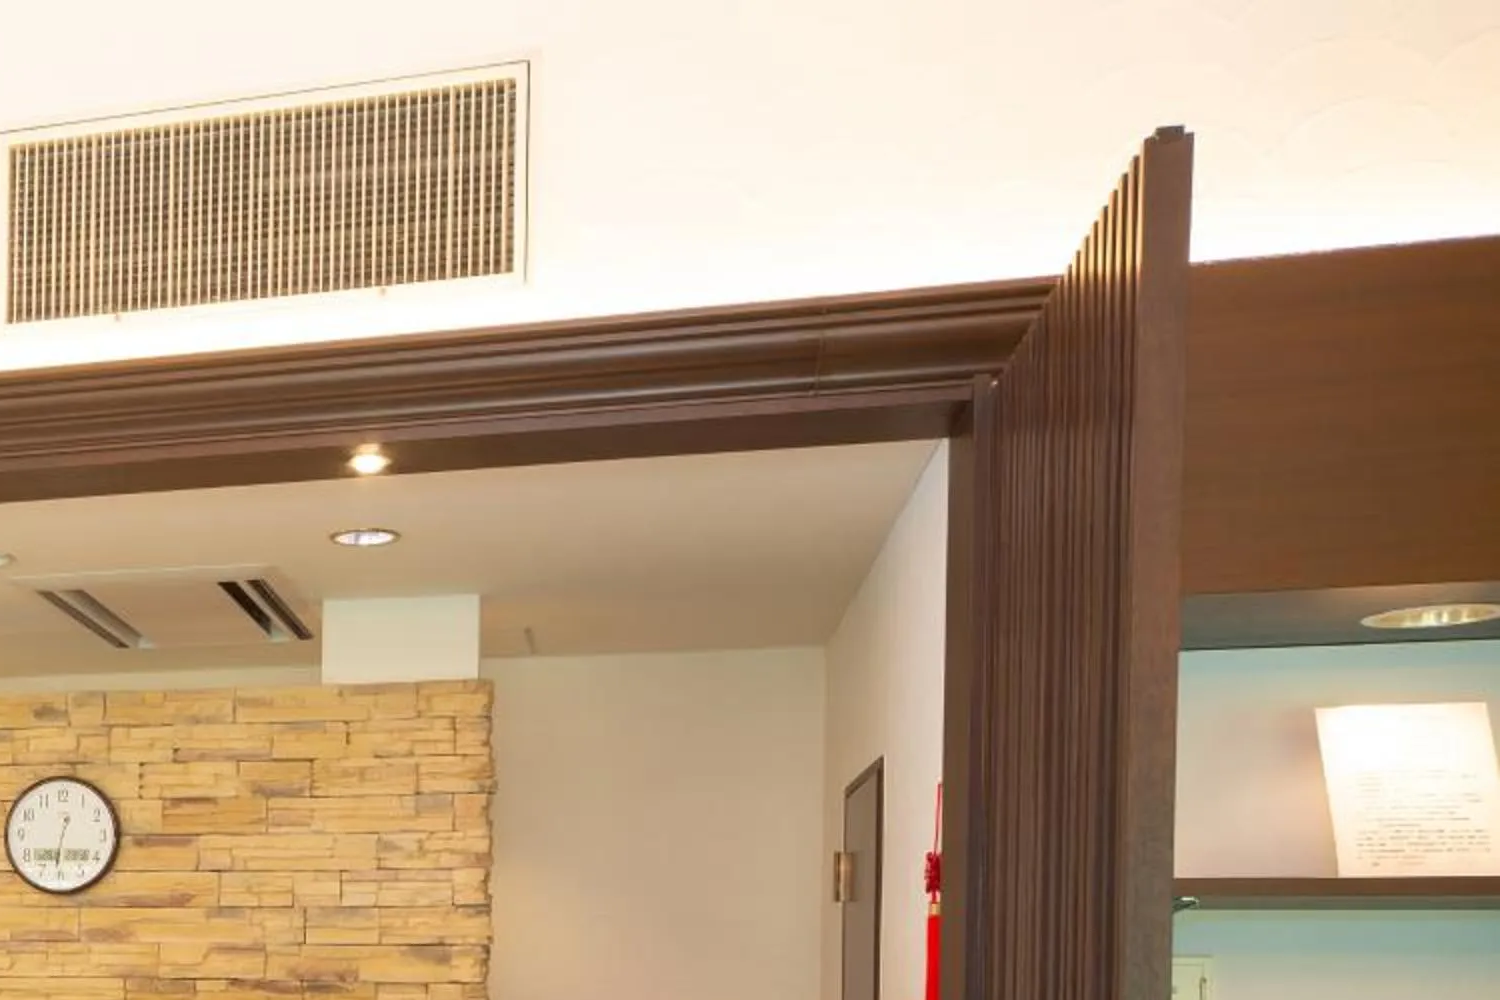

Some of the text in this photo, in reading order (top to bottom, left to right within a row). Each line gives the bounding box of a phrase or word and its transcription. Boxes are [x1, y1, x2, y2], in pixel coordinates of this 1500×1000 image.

[39, 793, 49, 808] 11
[57, 789, 69, 802] 12
[23, 808, 35, 821] 10
[92, 808, 101, 822] 2
[17, 828, 26, 841] 9
[100, 828, 107, 842] 3
[23, 848, 31, 862] 8
[92, 850, 101, 863] 4
[38, 863, 47, 877] 7
